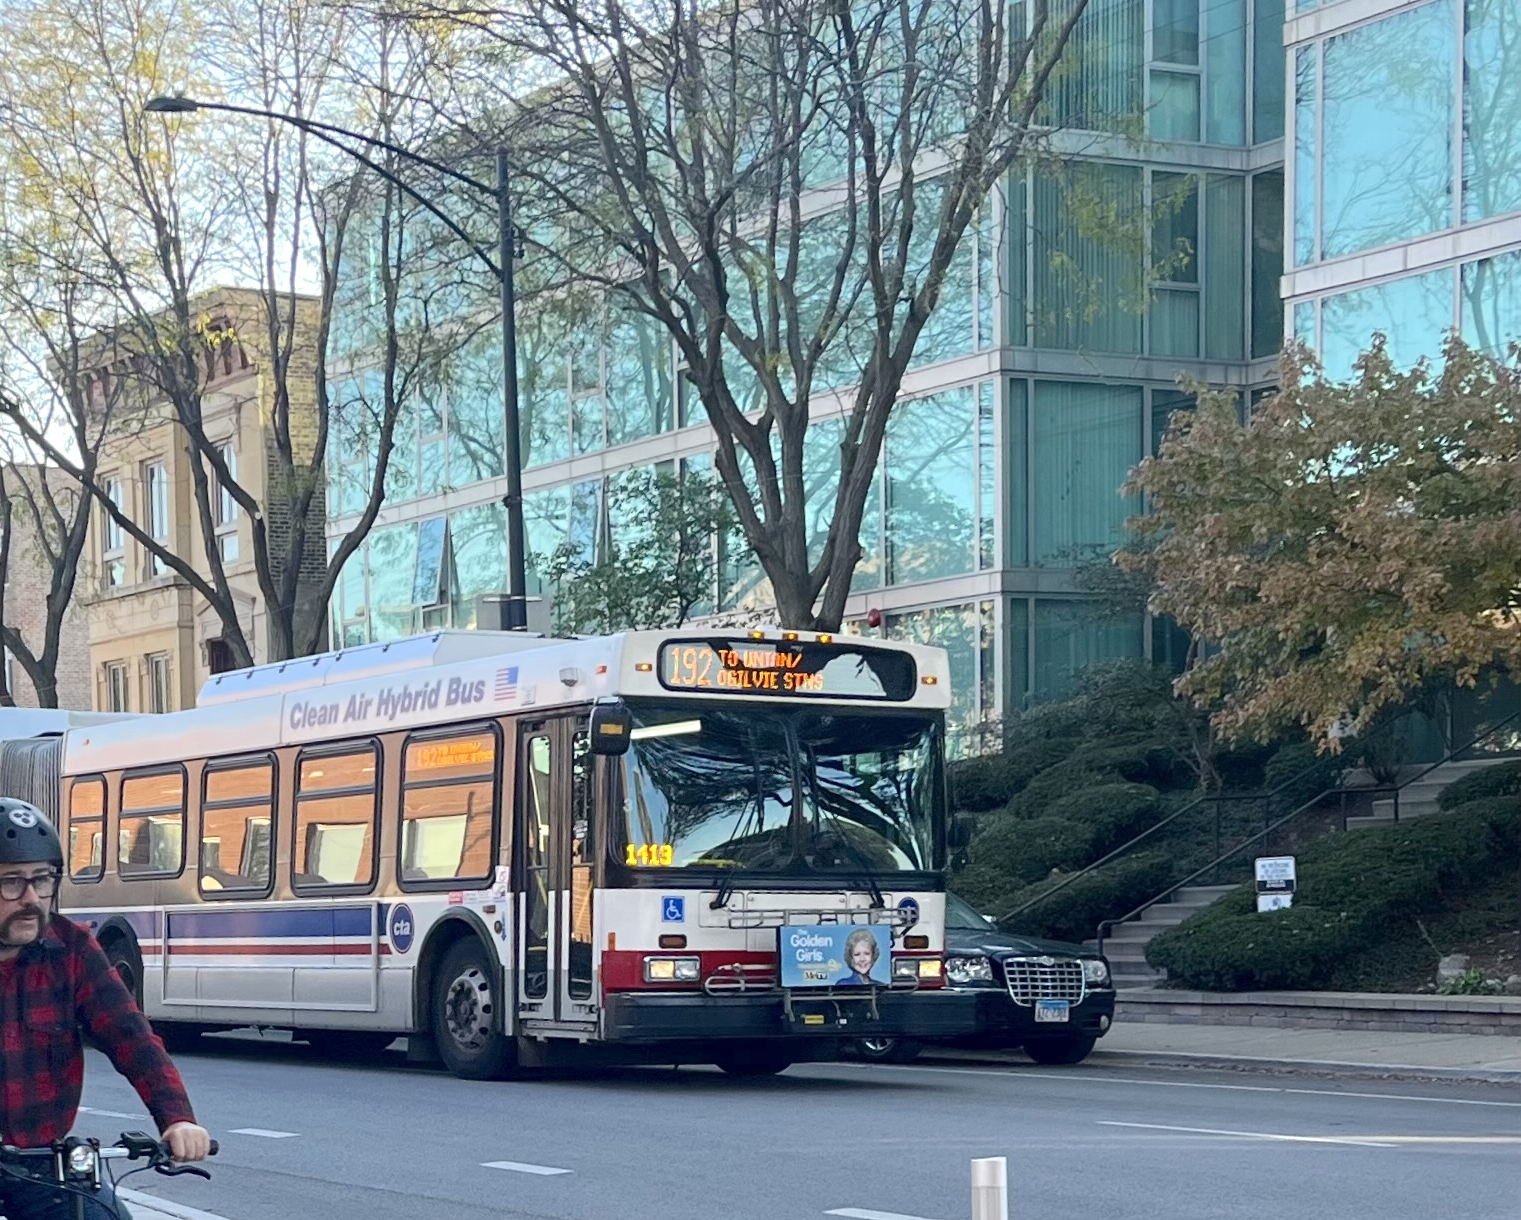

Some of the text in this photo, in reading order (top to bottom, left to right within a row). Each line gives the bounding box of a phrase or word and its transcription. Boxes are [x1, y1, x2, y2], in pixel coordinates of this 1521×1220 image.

[671, 647, 713, 686] 192
[718, 650, 802, 668] TO UNION/
[717, 670, 824, 690] OGILVIE STNS
[290, 676, 486, 730] Clean Air Hybrid Bus
[393, 919, 411, 936] cta
[790, 934, 833, 947] Golden
[795, 948, 823, 962] Girls
